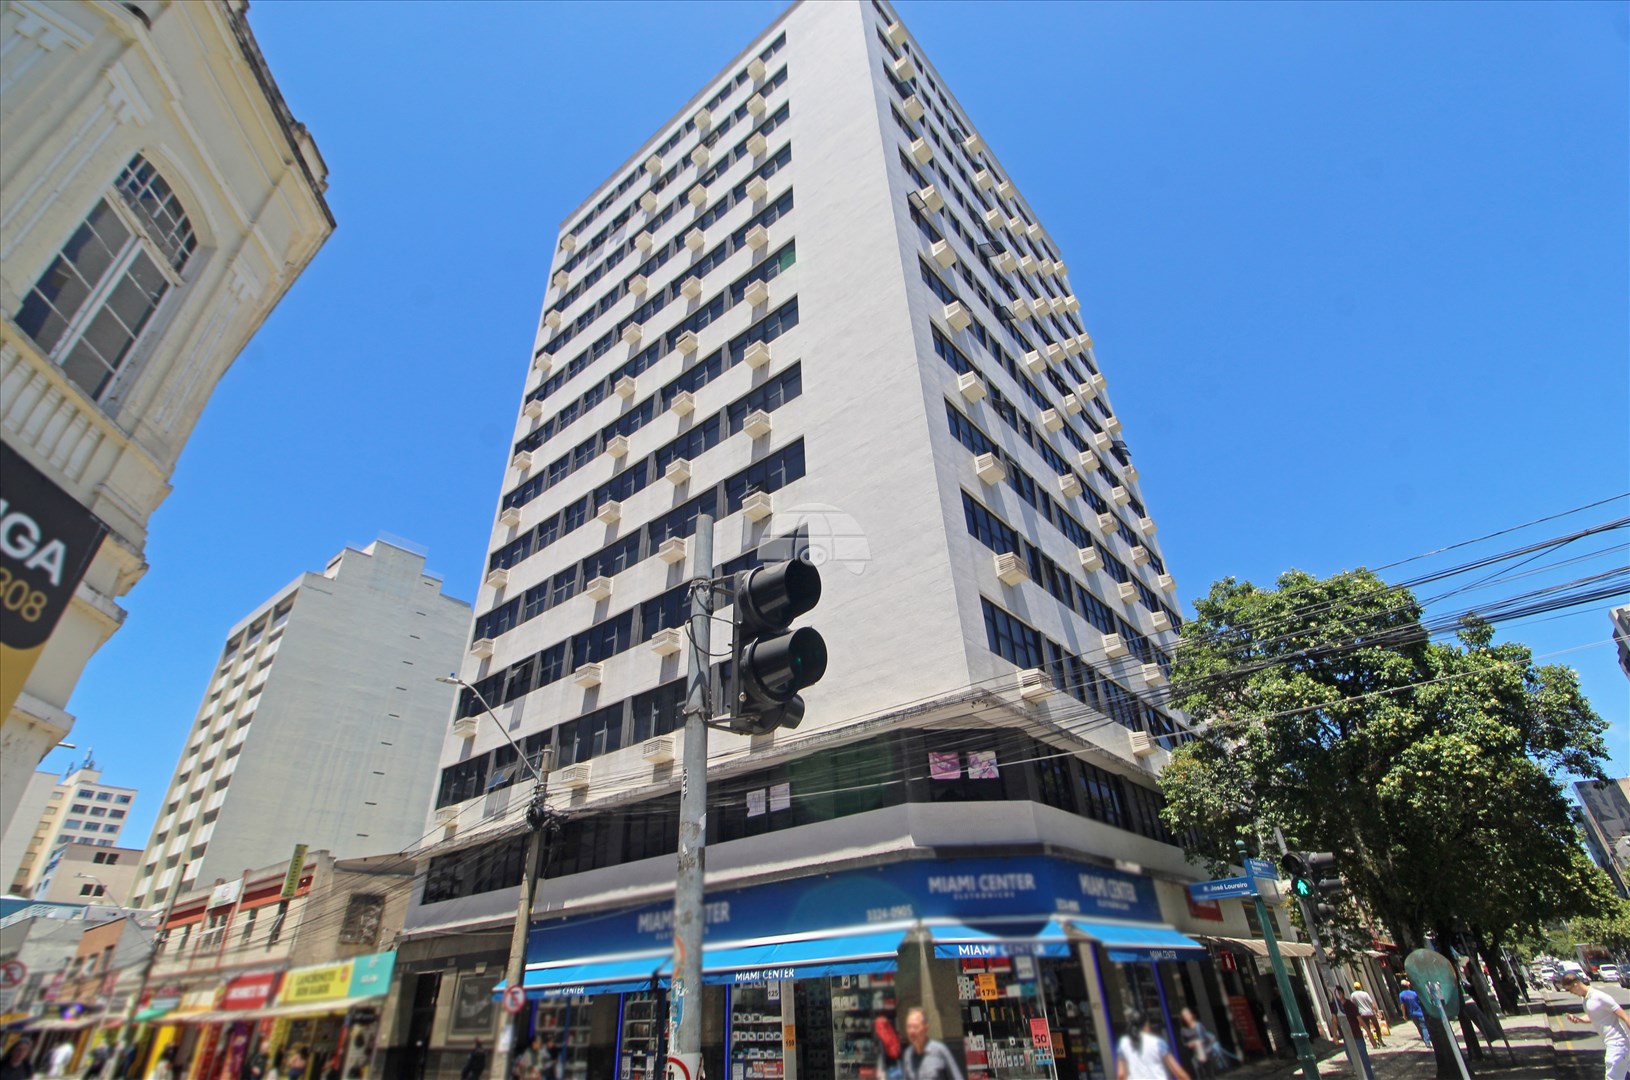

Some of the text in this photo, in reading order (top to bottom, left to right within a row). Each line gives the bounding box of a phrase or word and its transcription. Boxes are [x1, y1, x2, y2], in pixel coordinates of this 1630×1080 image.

[0, 498, 67, 587] GA
[928, 873, 1036, 894] MIAMI CENTER
[1210, 883, 1223, 891] José
[1224, 882, 1248, 891] Loureiro
[637, 911, 674, 934] MIAM
[958, 945, 996, 955] MIAMI
[735, 968, 795, 982] MIAMI CENTER
[562, 986, 585, 995] CENTER
[768, 989, 778, 997] 125
[1034, 1034, 1047, 1044] 50
